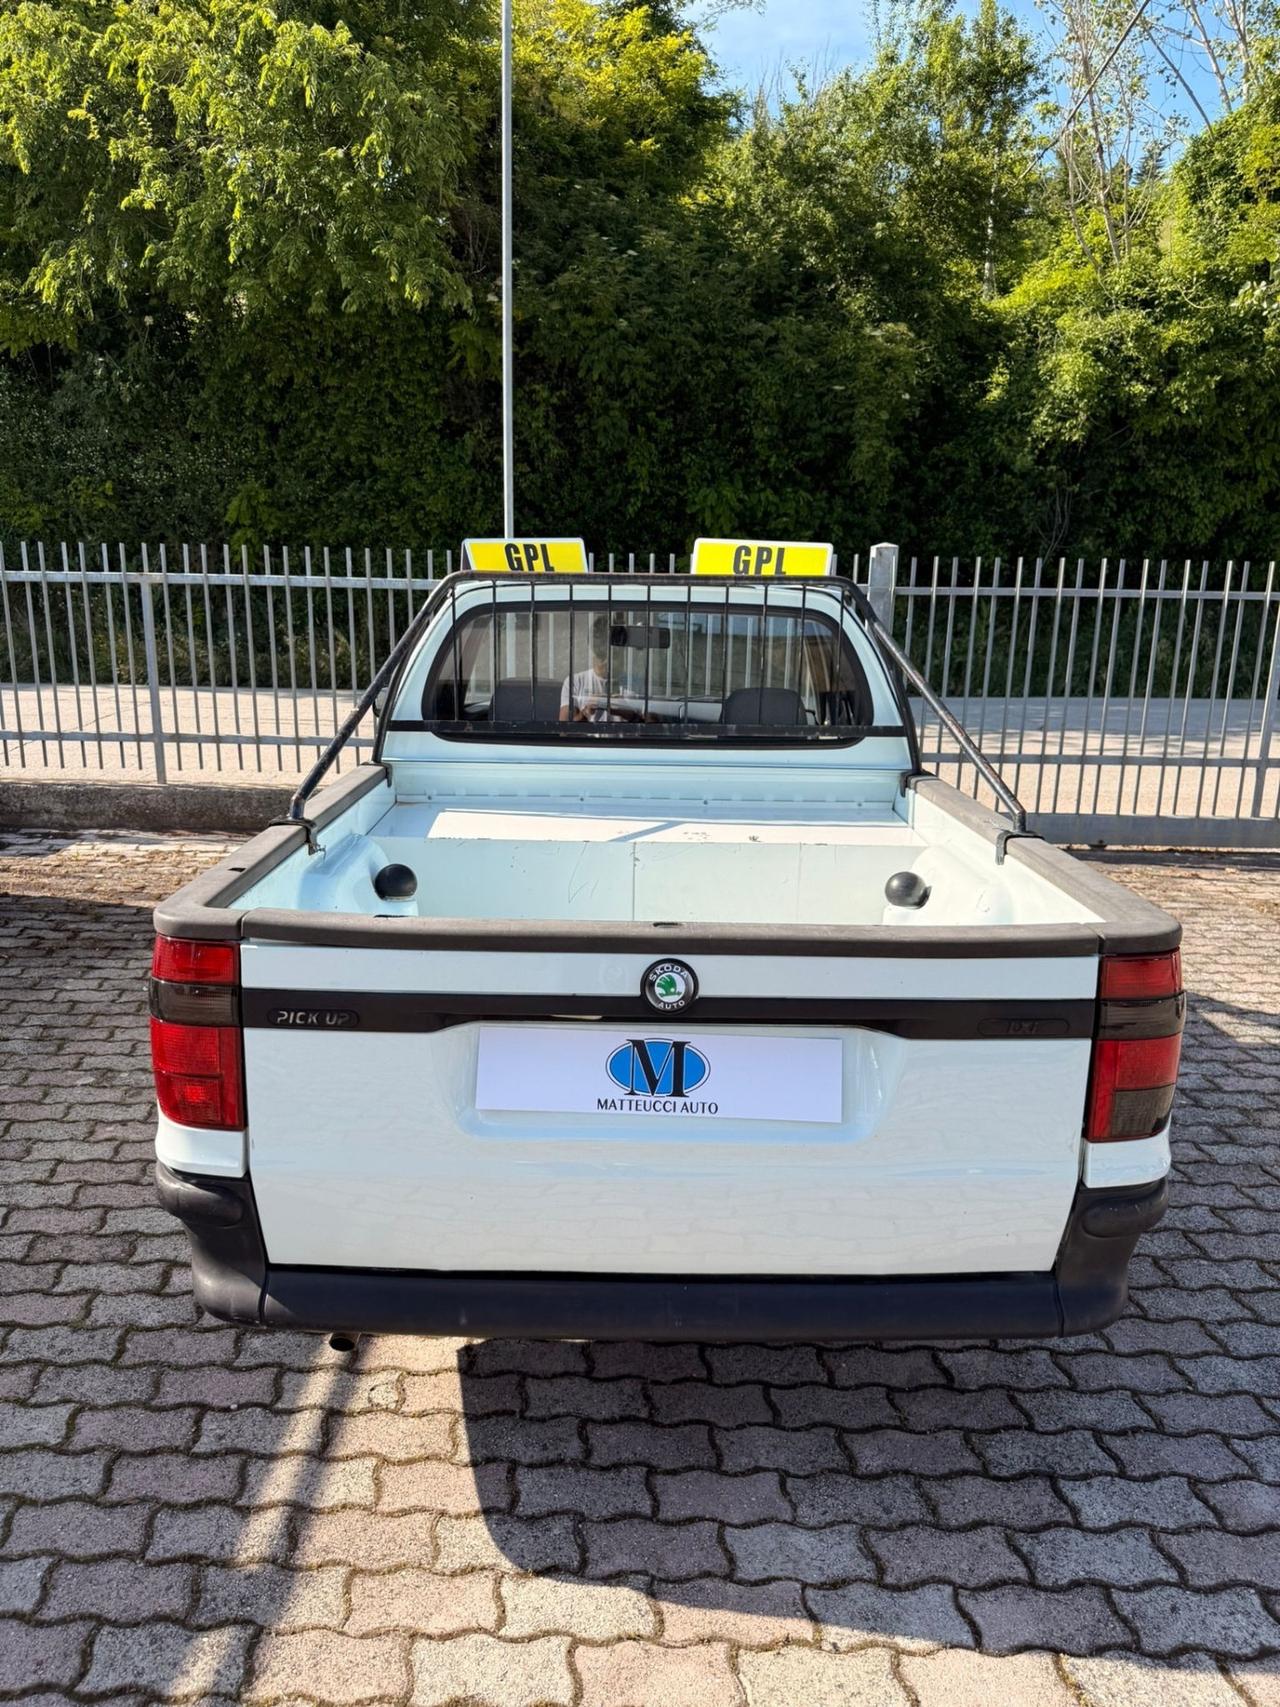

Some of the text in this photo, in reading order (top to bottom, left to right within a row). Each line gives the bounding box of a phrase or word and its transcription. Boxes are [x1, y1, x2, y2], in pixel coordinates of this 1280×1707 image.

[504, 543, 555, 571] GPL
[733, 545, 787, 575] GPL
[657, 1000, 685, 1010] AUTO
[276, 1010, 349, 1026] PICK UP
[624, 1039, 691, 1097] M
[597, 1098, 719, 1115] MATTEUCCI AUTO
